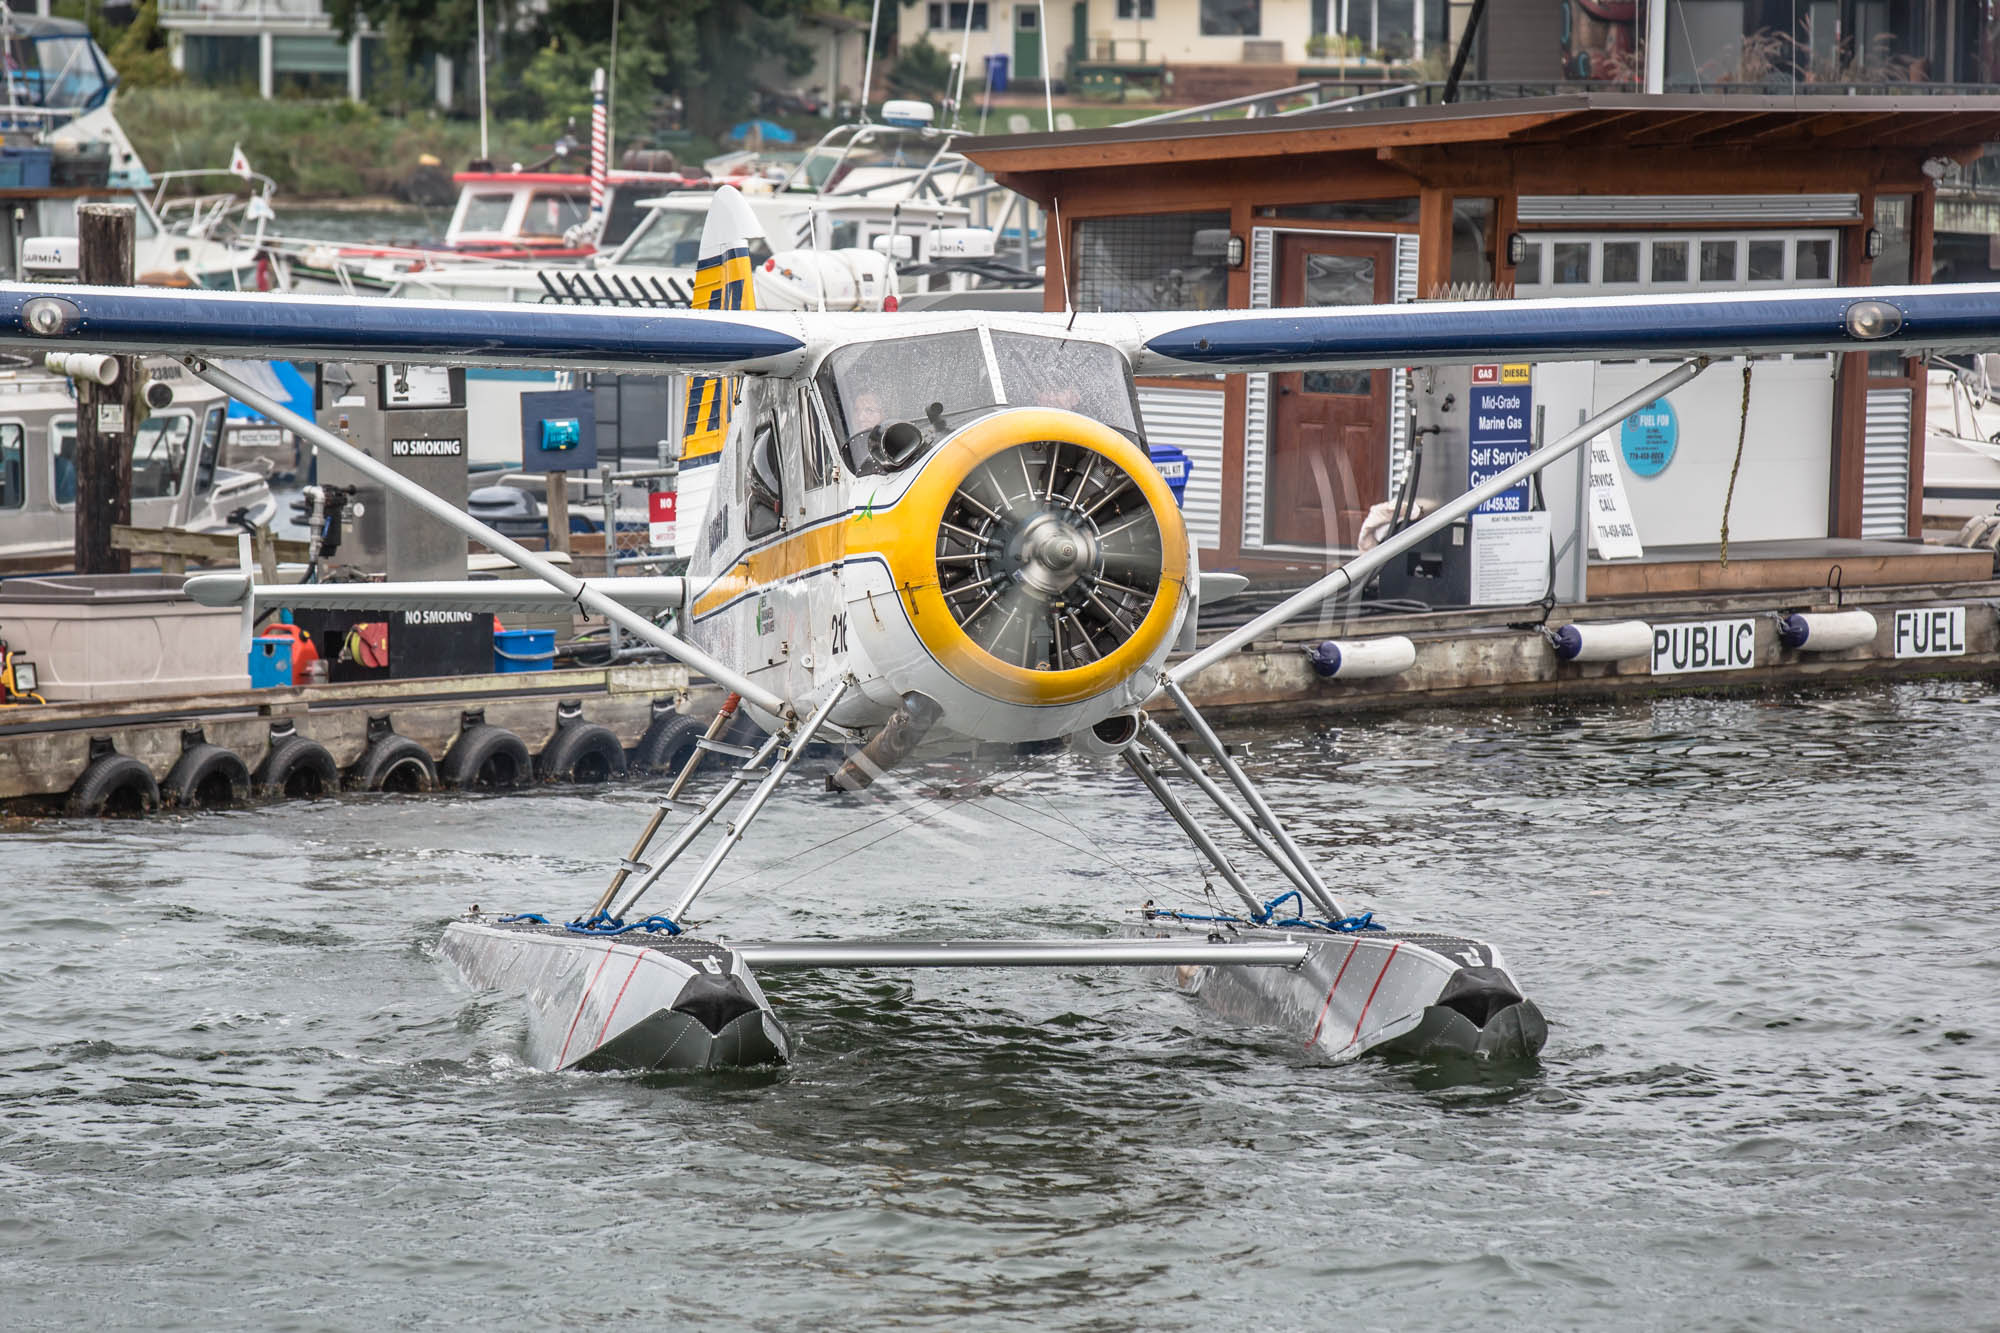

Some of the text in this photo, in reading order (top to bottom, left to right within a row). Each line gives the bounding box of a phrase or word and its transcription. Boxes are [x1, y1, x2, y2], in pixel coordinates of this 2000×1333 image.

[1478, 368, 1493, 379] GAS
[1504, 368, 1528, 378] DIESEL
[1481, 394, 1520, 409] Mid-Grade
[1478, 415, 1523, 430] Marine Gas
[1640, 414, 1655, 427] FUEL
[393, 440, 460, 455] NO SMOKING
[1471, 448, 1491, 466] Self
[1592, 450, 1610, 463] FUEL
[660, 498, 672, 509] NO
[1599, 499, 1616, 512] CALL
[405, 610, 473, 625] NO SMOKING
[1896, 611, 1963, 656] FUEL
[1653, 622, 1753, 671] PUBLIC
